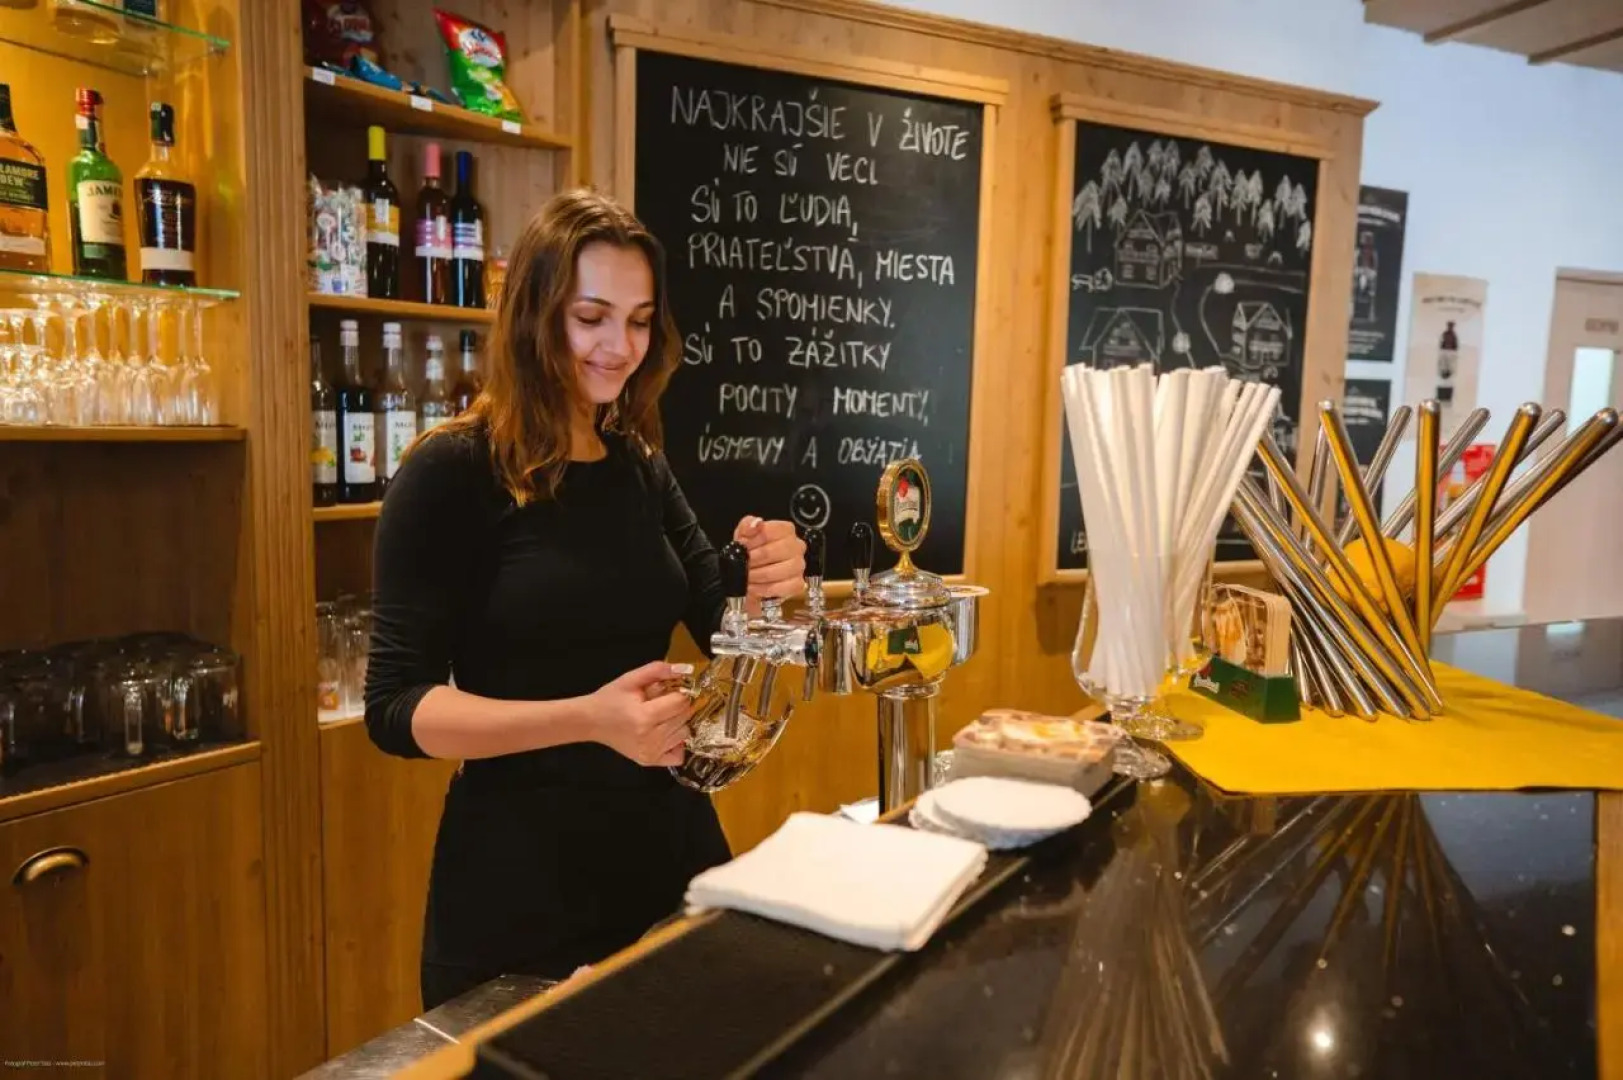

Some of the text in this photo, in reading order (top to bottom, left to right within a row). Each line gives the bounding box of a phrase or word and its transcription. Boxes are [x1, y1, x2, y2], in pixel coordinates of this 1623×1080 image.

[671, 85, 847, 140] NAJKRAJŠIE
[867, 111, 883, 147] V
[0, 162, 40, 180] LAMORE
[723, 143, 759, 174] NIE
[774, 143, 803, 176] SÚ
[691, 177, 720, 224] SÚ
[733, 190, 758, 223] TO
[875, 250, 955, 287] MIESTA
[718, 283, 735, 319] A
[683, 321, 892, 372] SÚ TO ZÁŽITKY
[719, 383, 798, 419] POCITY
[698, 422, 785, 466] ÚSMEVY
[802, 435, 818, 469] A
